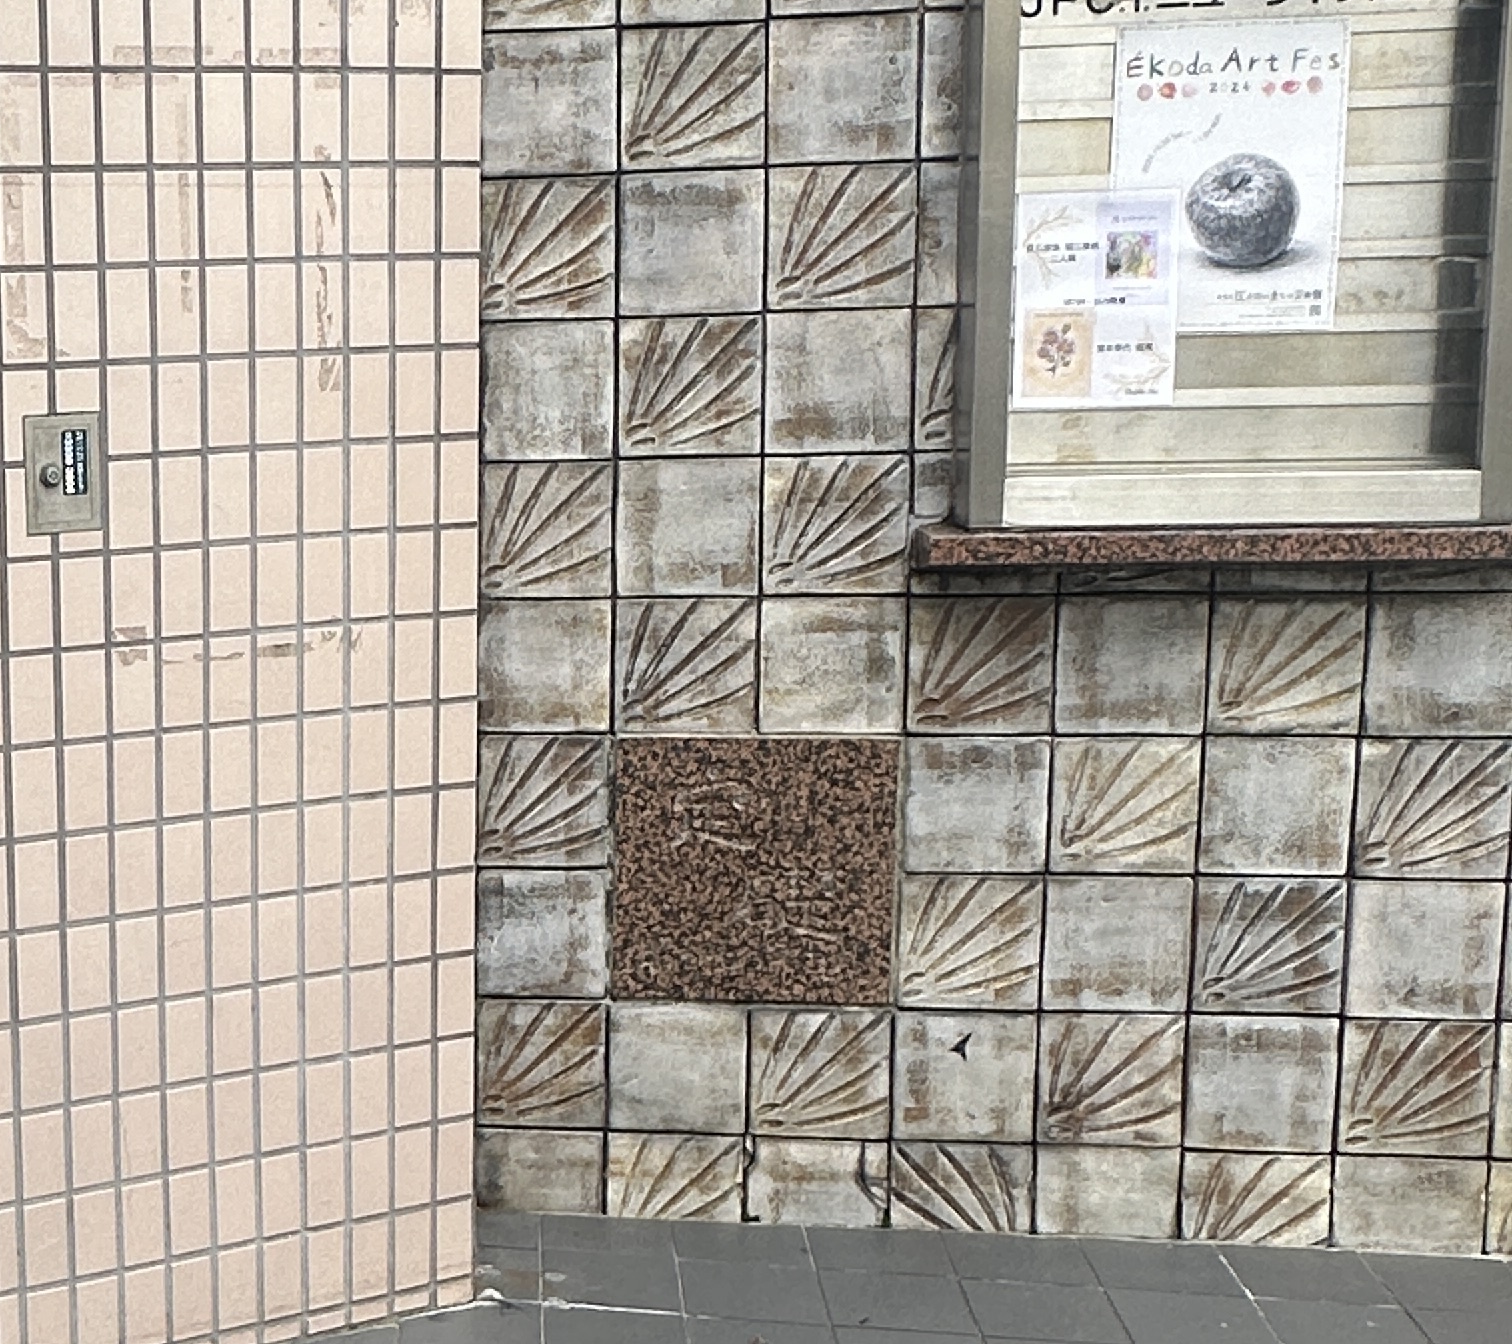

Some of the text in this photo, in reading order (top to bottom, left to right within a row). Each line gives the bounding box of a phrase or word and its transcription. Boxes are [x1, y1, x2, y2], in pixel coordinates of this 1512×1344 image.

[1221, 47, 1279, 72] Art
[1291, 48, 1340, 73] Fes
[1208, 81, 1250, 94] 2024
